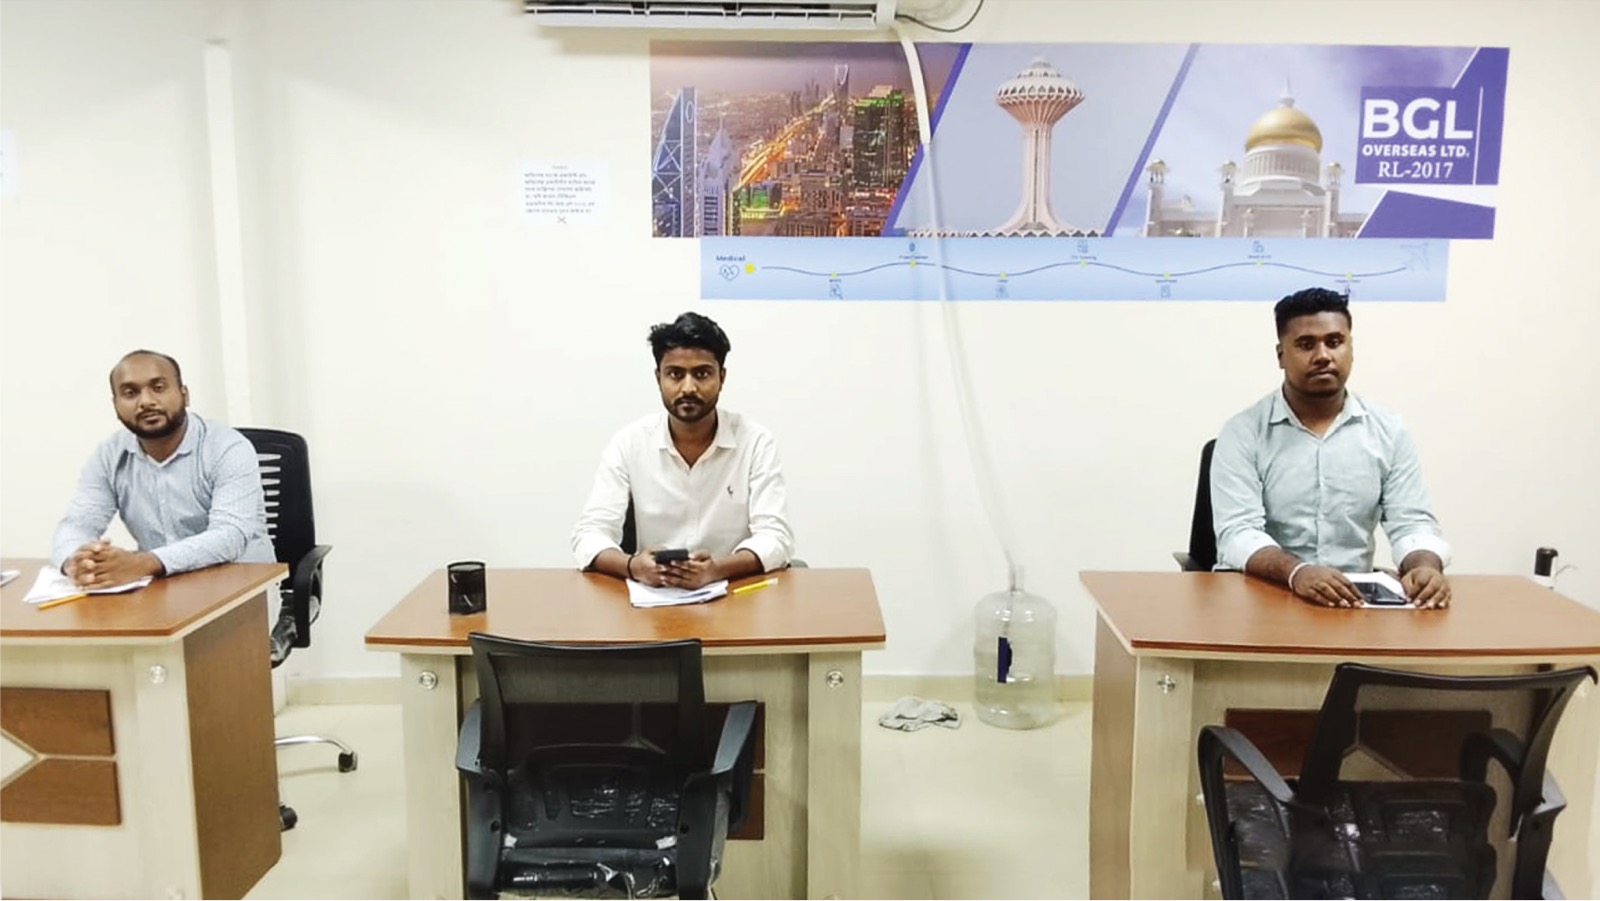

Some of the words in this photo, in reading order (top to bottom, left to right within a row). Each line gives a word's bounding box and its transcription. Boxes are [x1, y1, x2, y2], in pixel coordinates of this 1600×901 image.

[1362, 97, 1474, 140] BGL
[1362, 144, 1437, 157] OVERSEAS
[1377, 160, 1454, 179] RL-2017
